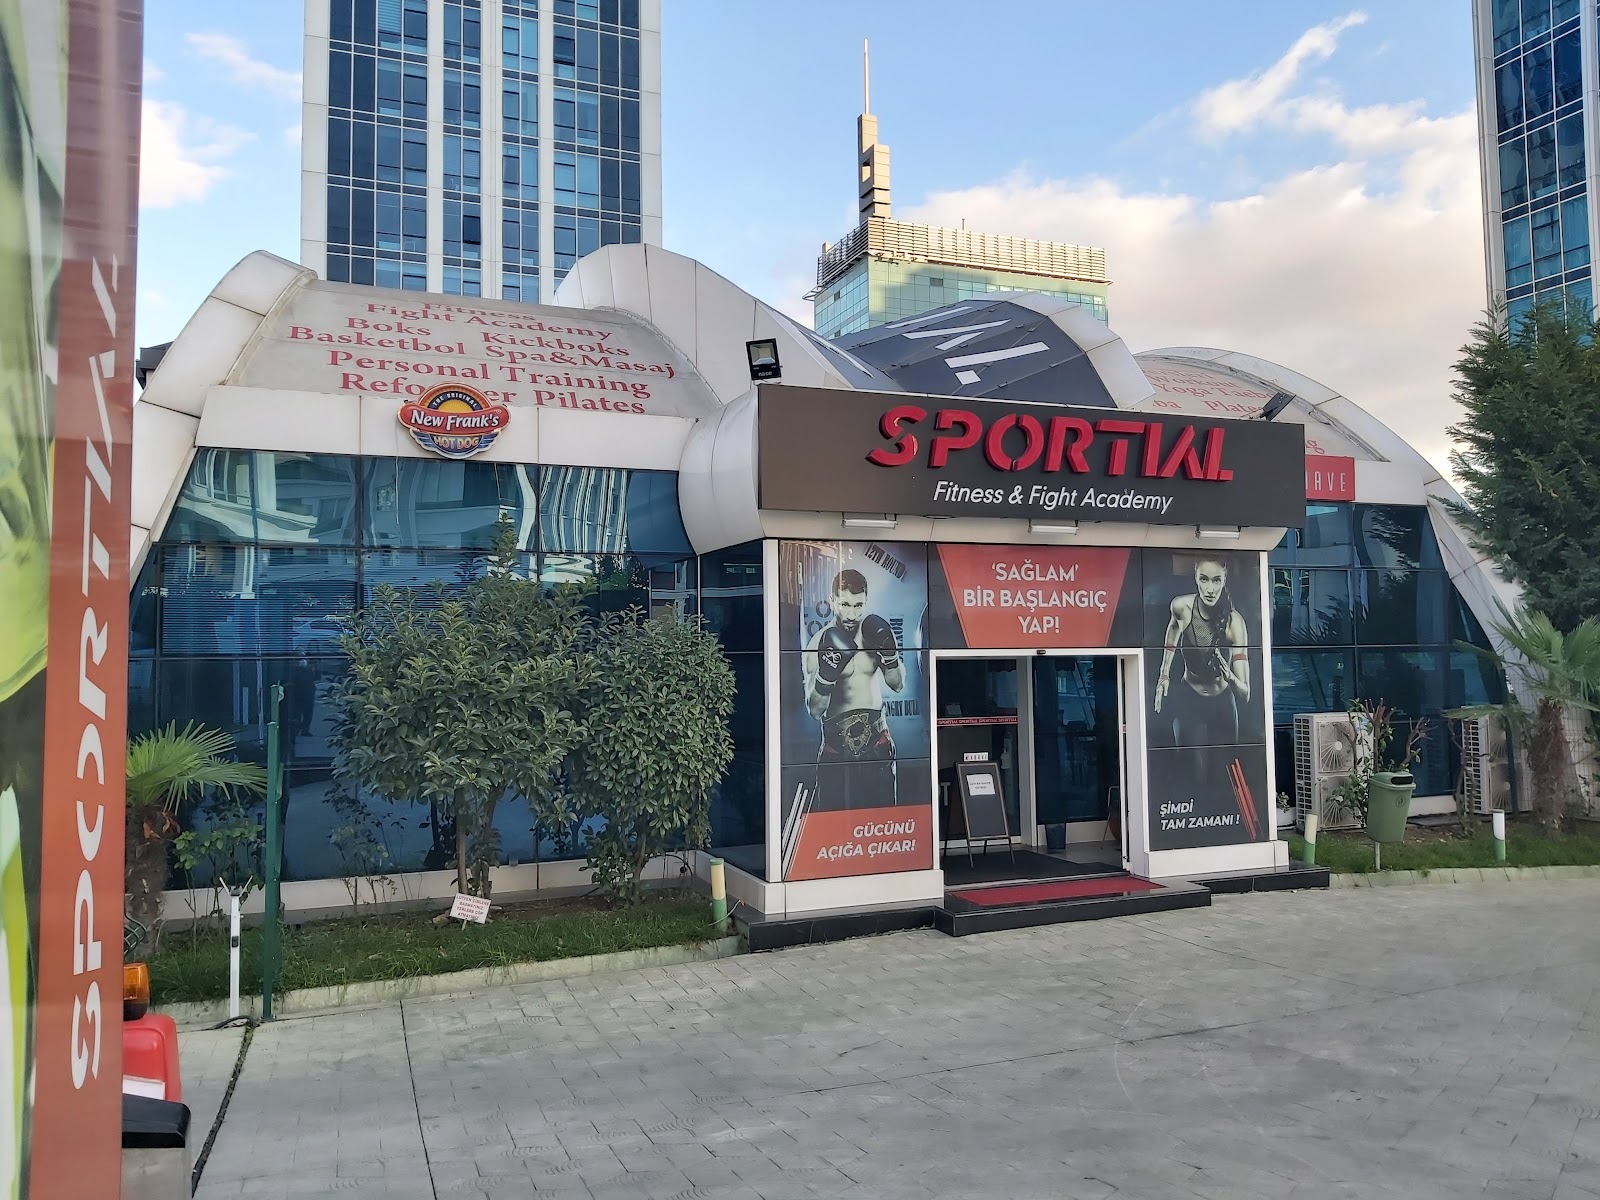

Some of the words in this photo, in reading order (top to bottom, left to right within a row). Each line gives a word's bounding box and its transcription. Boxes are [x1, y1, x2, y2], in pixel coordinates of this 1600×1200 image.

[367, 303, 456, 322] Fight
[464, 315, 613, 341] Academy
[423, 303, 537, 321] Fitness
[344, 316, 431, 336] Boks
[480, 331, 630, 357] Kickboks
[287, 325, 466, 355] Basketbol
[485, 345, 676, 379] Spa&Masaj
[327, 349, 491, 380] Personal
[500, 365, 651, 400] Training
[338, 372, 517, 403] Refoer
[533, 389, 646, 414] Pilates
[433, 396, 445, 407] THE
[446, 392, 478, 408] ORIGINAL
[1152, 383, 1213, 397] Yoga
[411, 409, 444, 427] New
[446, 413, 500, 431] Frank's
[433, 435, 456, 449] HOT
[457, 436, 480, 450] DOG
[865, 404, 1235, 482] SPORTIAL
[933, 480, 1003, 505] Fitness
[1011, 485, 1024, 505] &
[1028, 485, 1078, 511] Fight
[1080, 487, 1174, 515] Academy
[963, 585, 996, 608] BİR
[1000, 589, 1108, 613] BAŞLANGIÇ
[1017, 615, 1061, 634] YAP!
[1159, 798, 1195, 818] ŞİMDİ
[852, 818, 916, 839] GÜCÜNÜ
[1160, 818, 1186, 831] TAM
[816, 841, 864, 862] AÇIĞA
[867, 839, 917, 859] ÇIKAR!
